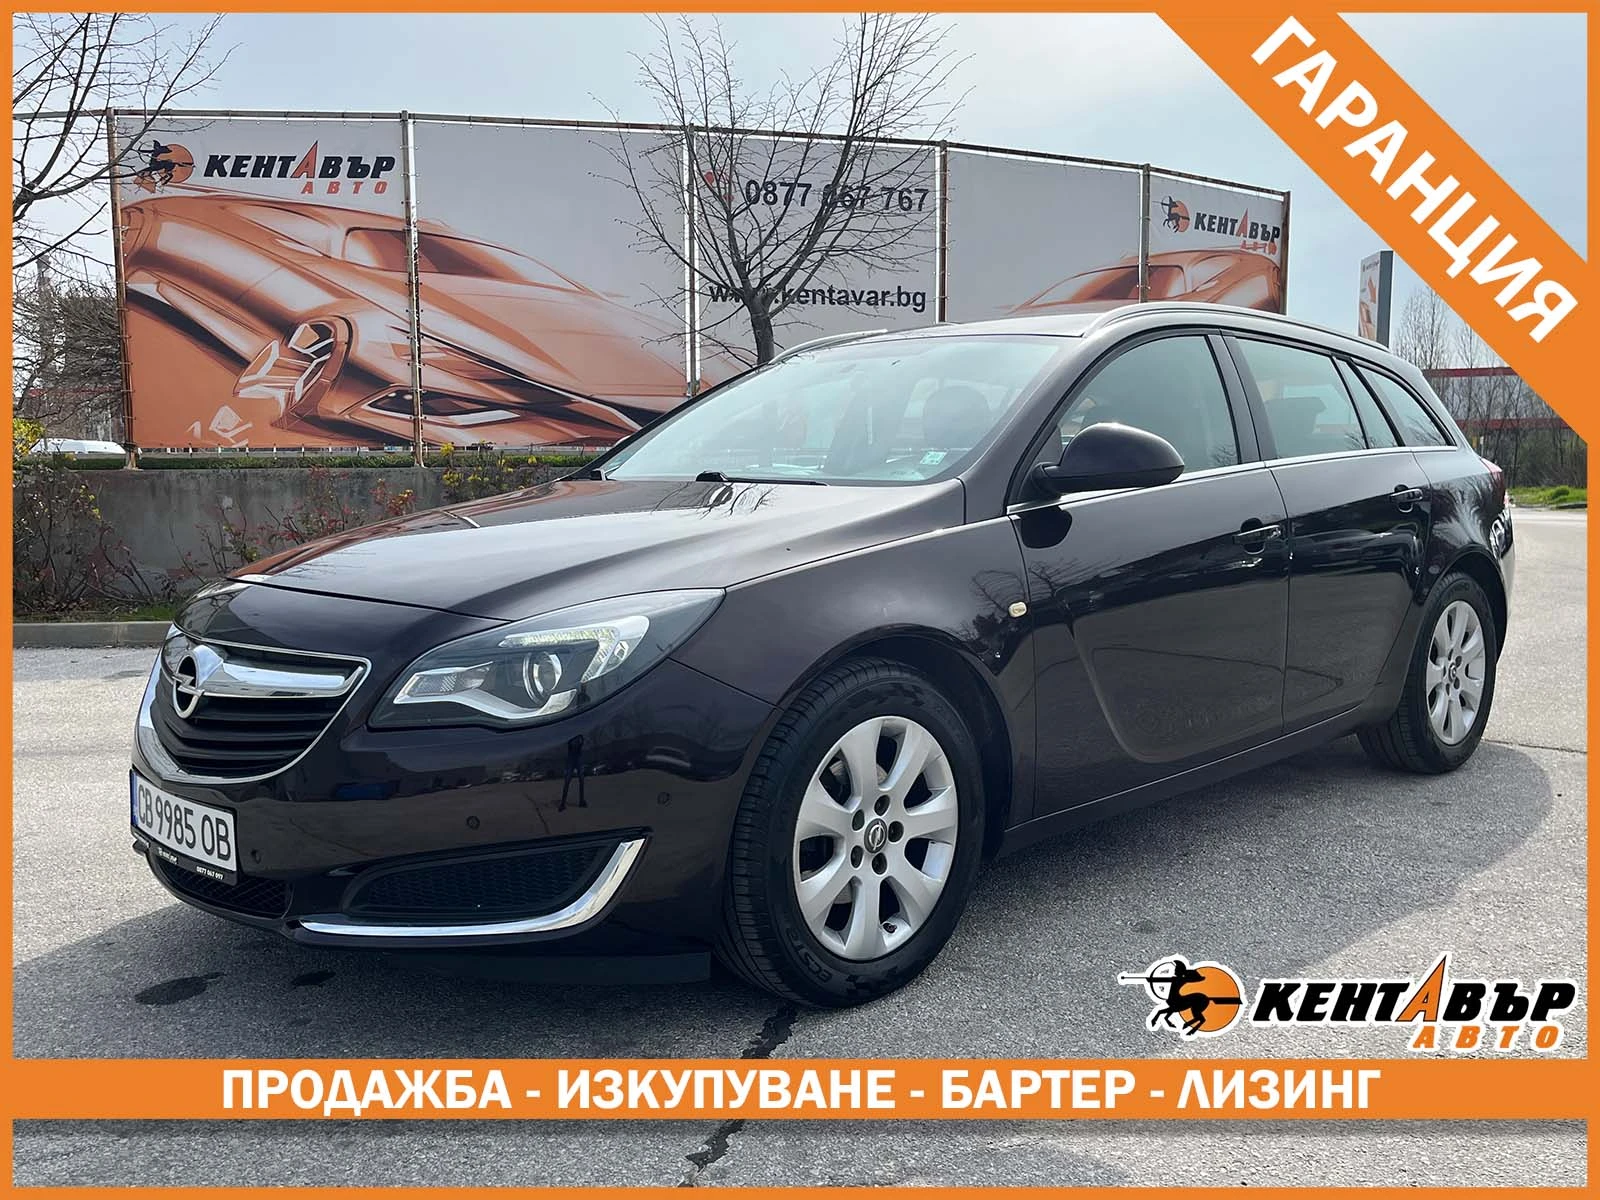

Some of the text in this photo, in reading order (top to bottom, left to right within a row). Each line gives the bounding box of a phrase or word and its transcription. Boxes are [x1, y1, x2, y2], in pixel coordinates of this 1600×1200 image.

[203, 140, 396, 179] КЕНТАВЪР
[300, 181, 388, 195] АВТО
[745, 180, 812, 207] 0877
[880, 187, 929, 212] 767
[1194, 208, 1280, 243] КЕНТАВЪР
[708, 285, 926, 313] w.kentavar.bg
[155, 795, 196, 849] 9985
